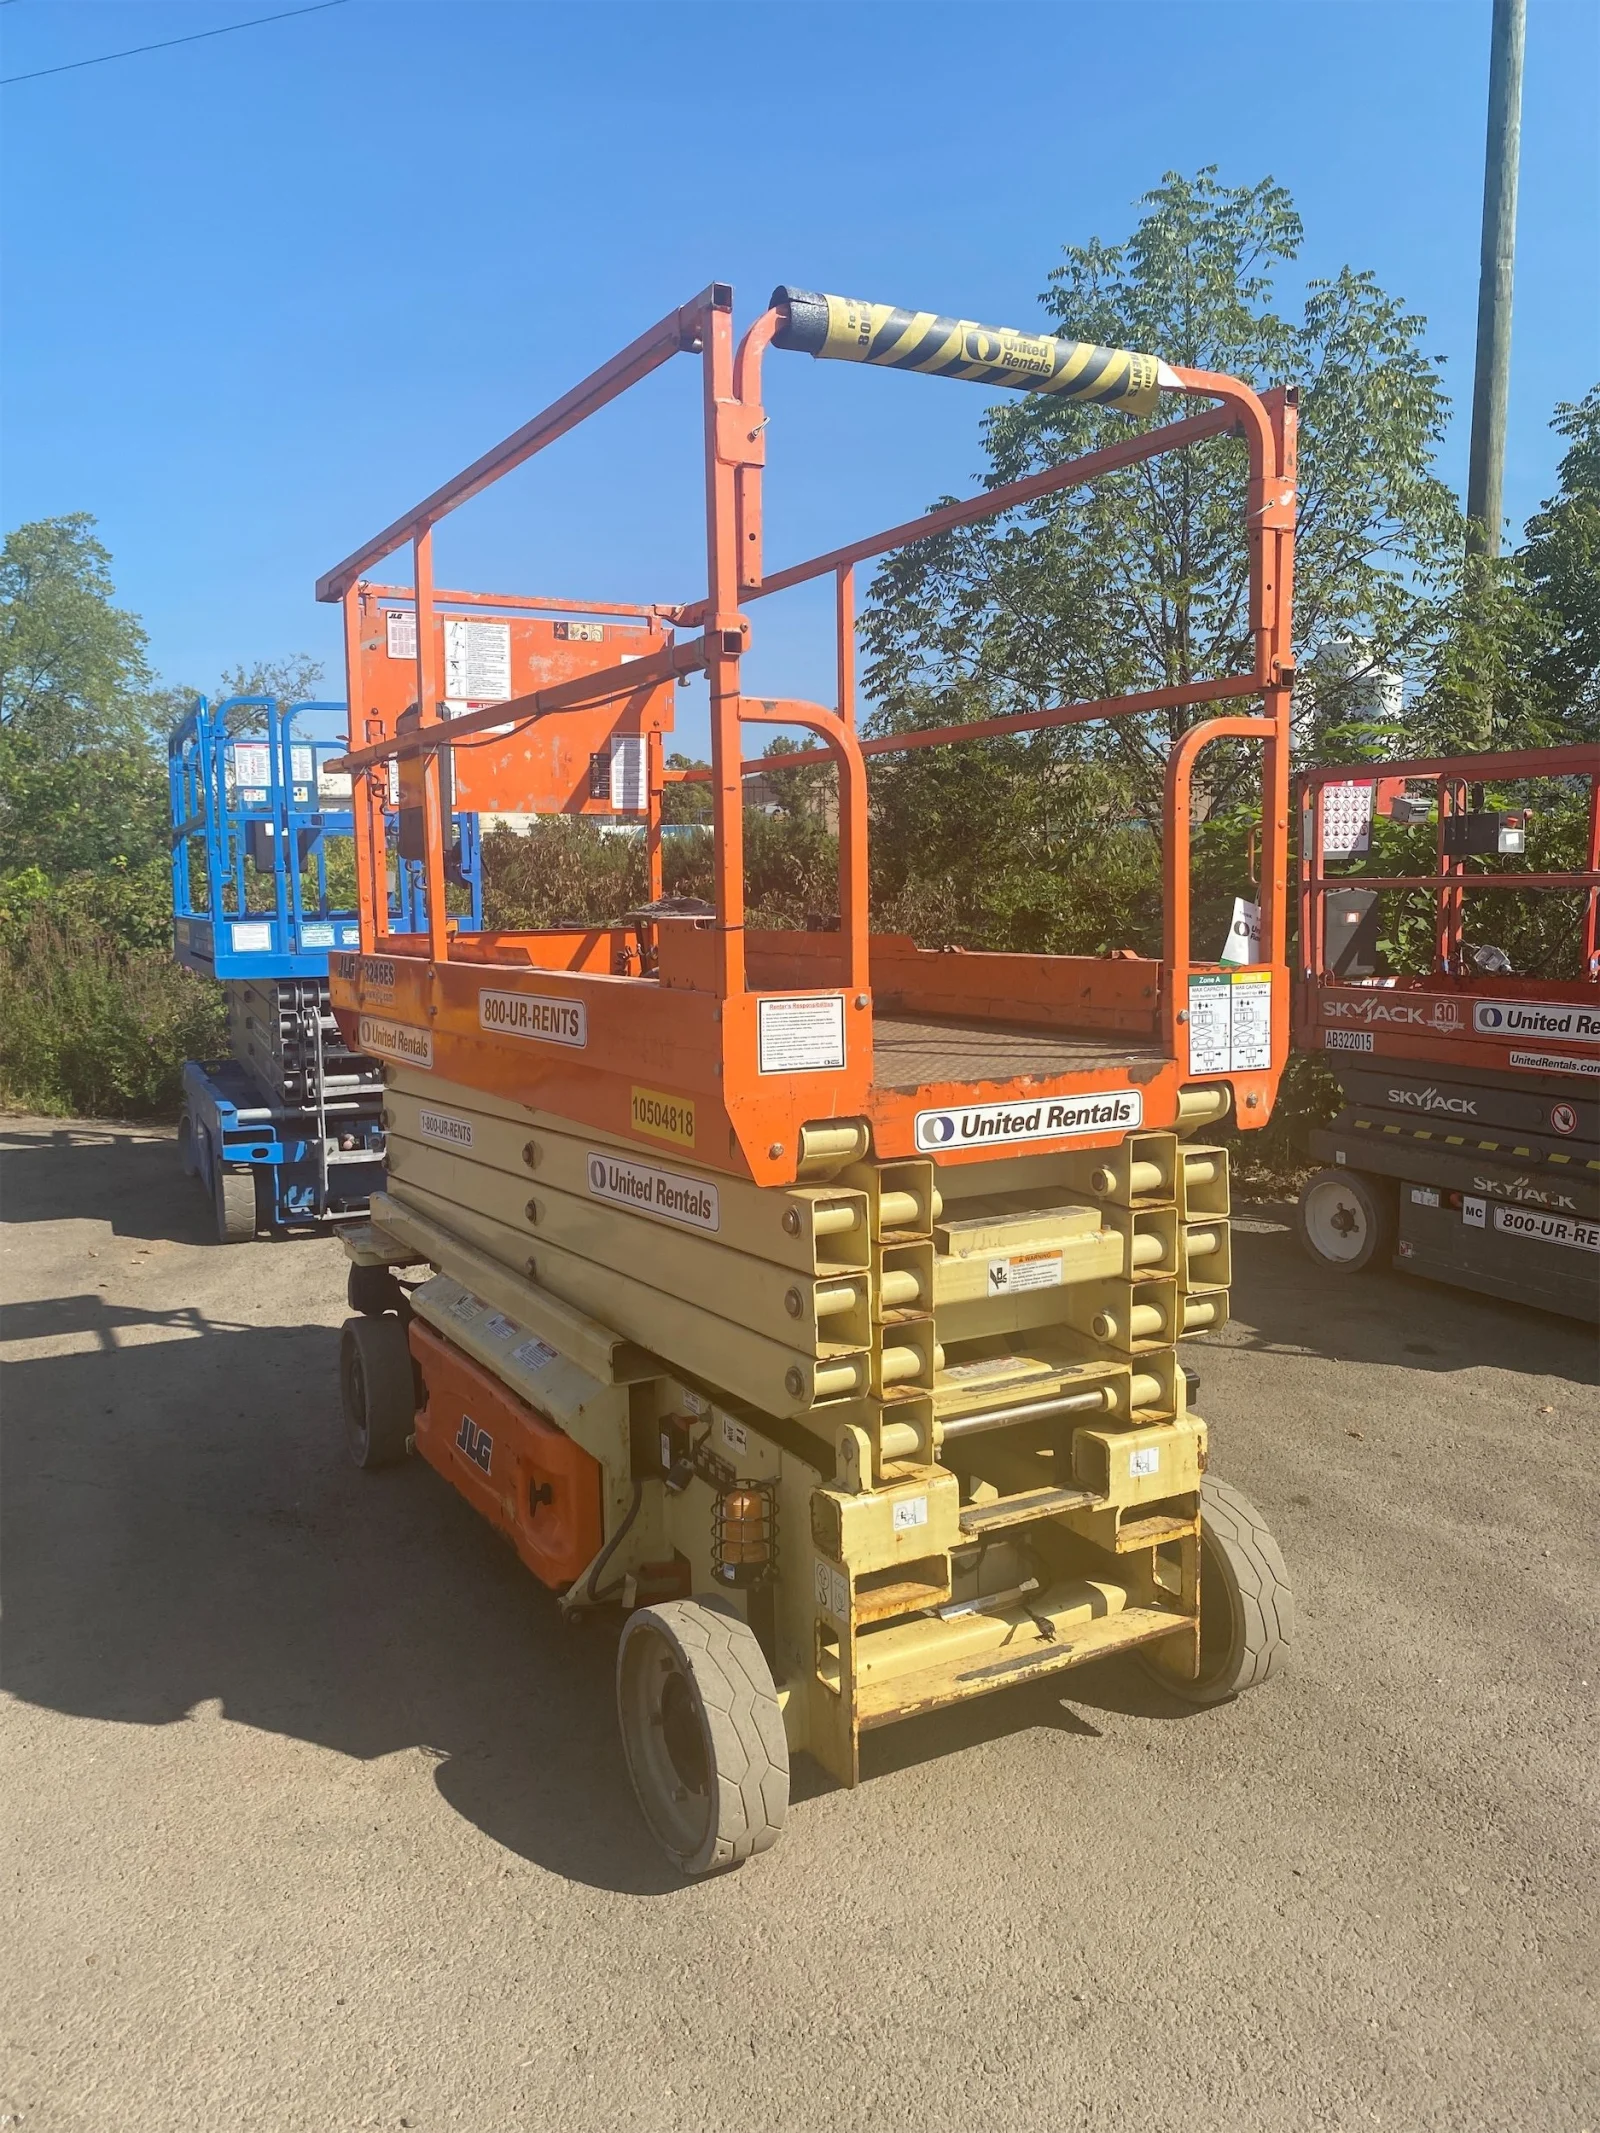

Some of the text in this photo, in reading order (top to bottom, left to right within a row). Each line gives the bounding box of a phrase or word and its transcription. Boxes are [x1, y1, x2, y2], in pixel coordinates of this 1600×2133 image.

[1003, 337, 1048, 357] United
[1001, 352, 1051, 373] Rentals
[364, 961, 395, 988] 3246ES
[1198, 976, 1215, 984] Zone
[485, 998, 579, 1037] 800-UR-RENTS
[1322, 997, 1425, 1024] SKYJACK
[1507, 1010, 1572, 1032] United
[372, 1024, 428, 1058] United Rentals
[1326, 1031, 1372, 1050] AB322015
[1388, 1086, 1477, 1115] SKYJACK
[422, 1115, 471, 1142] 1-800-UR-RENTS
[632, 1096, 694, 1137] 10504818
[961, 1099, 1131, 1138] United Rentals
[608, 1166, 711, 1220] United Rentals
[1465, 1205, 1483, 1218] MC
[1025, 1252, 1051, 1262] WARNING
[456, 1414, 494, 1477] JLG
